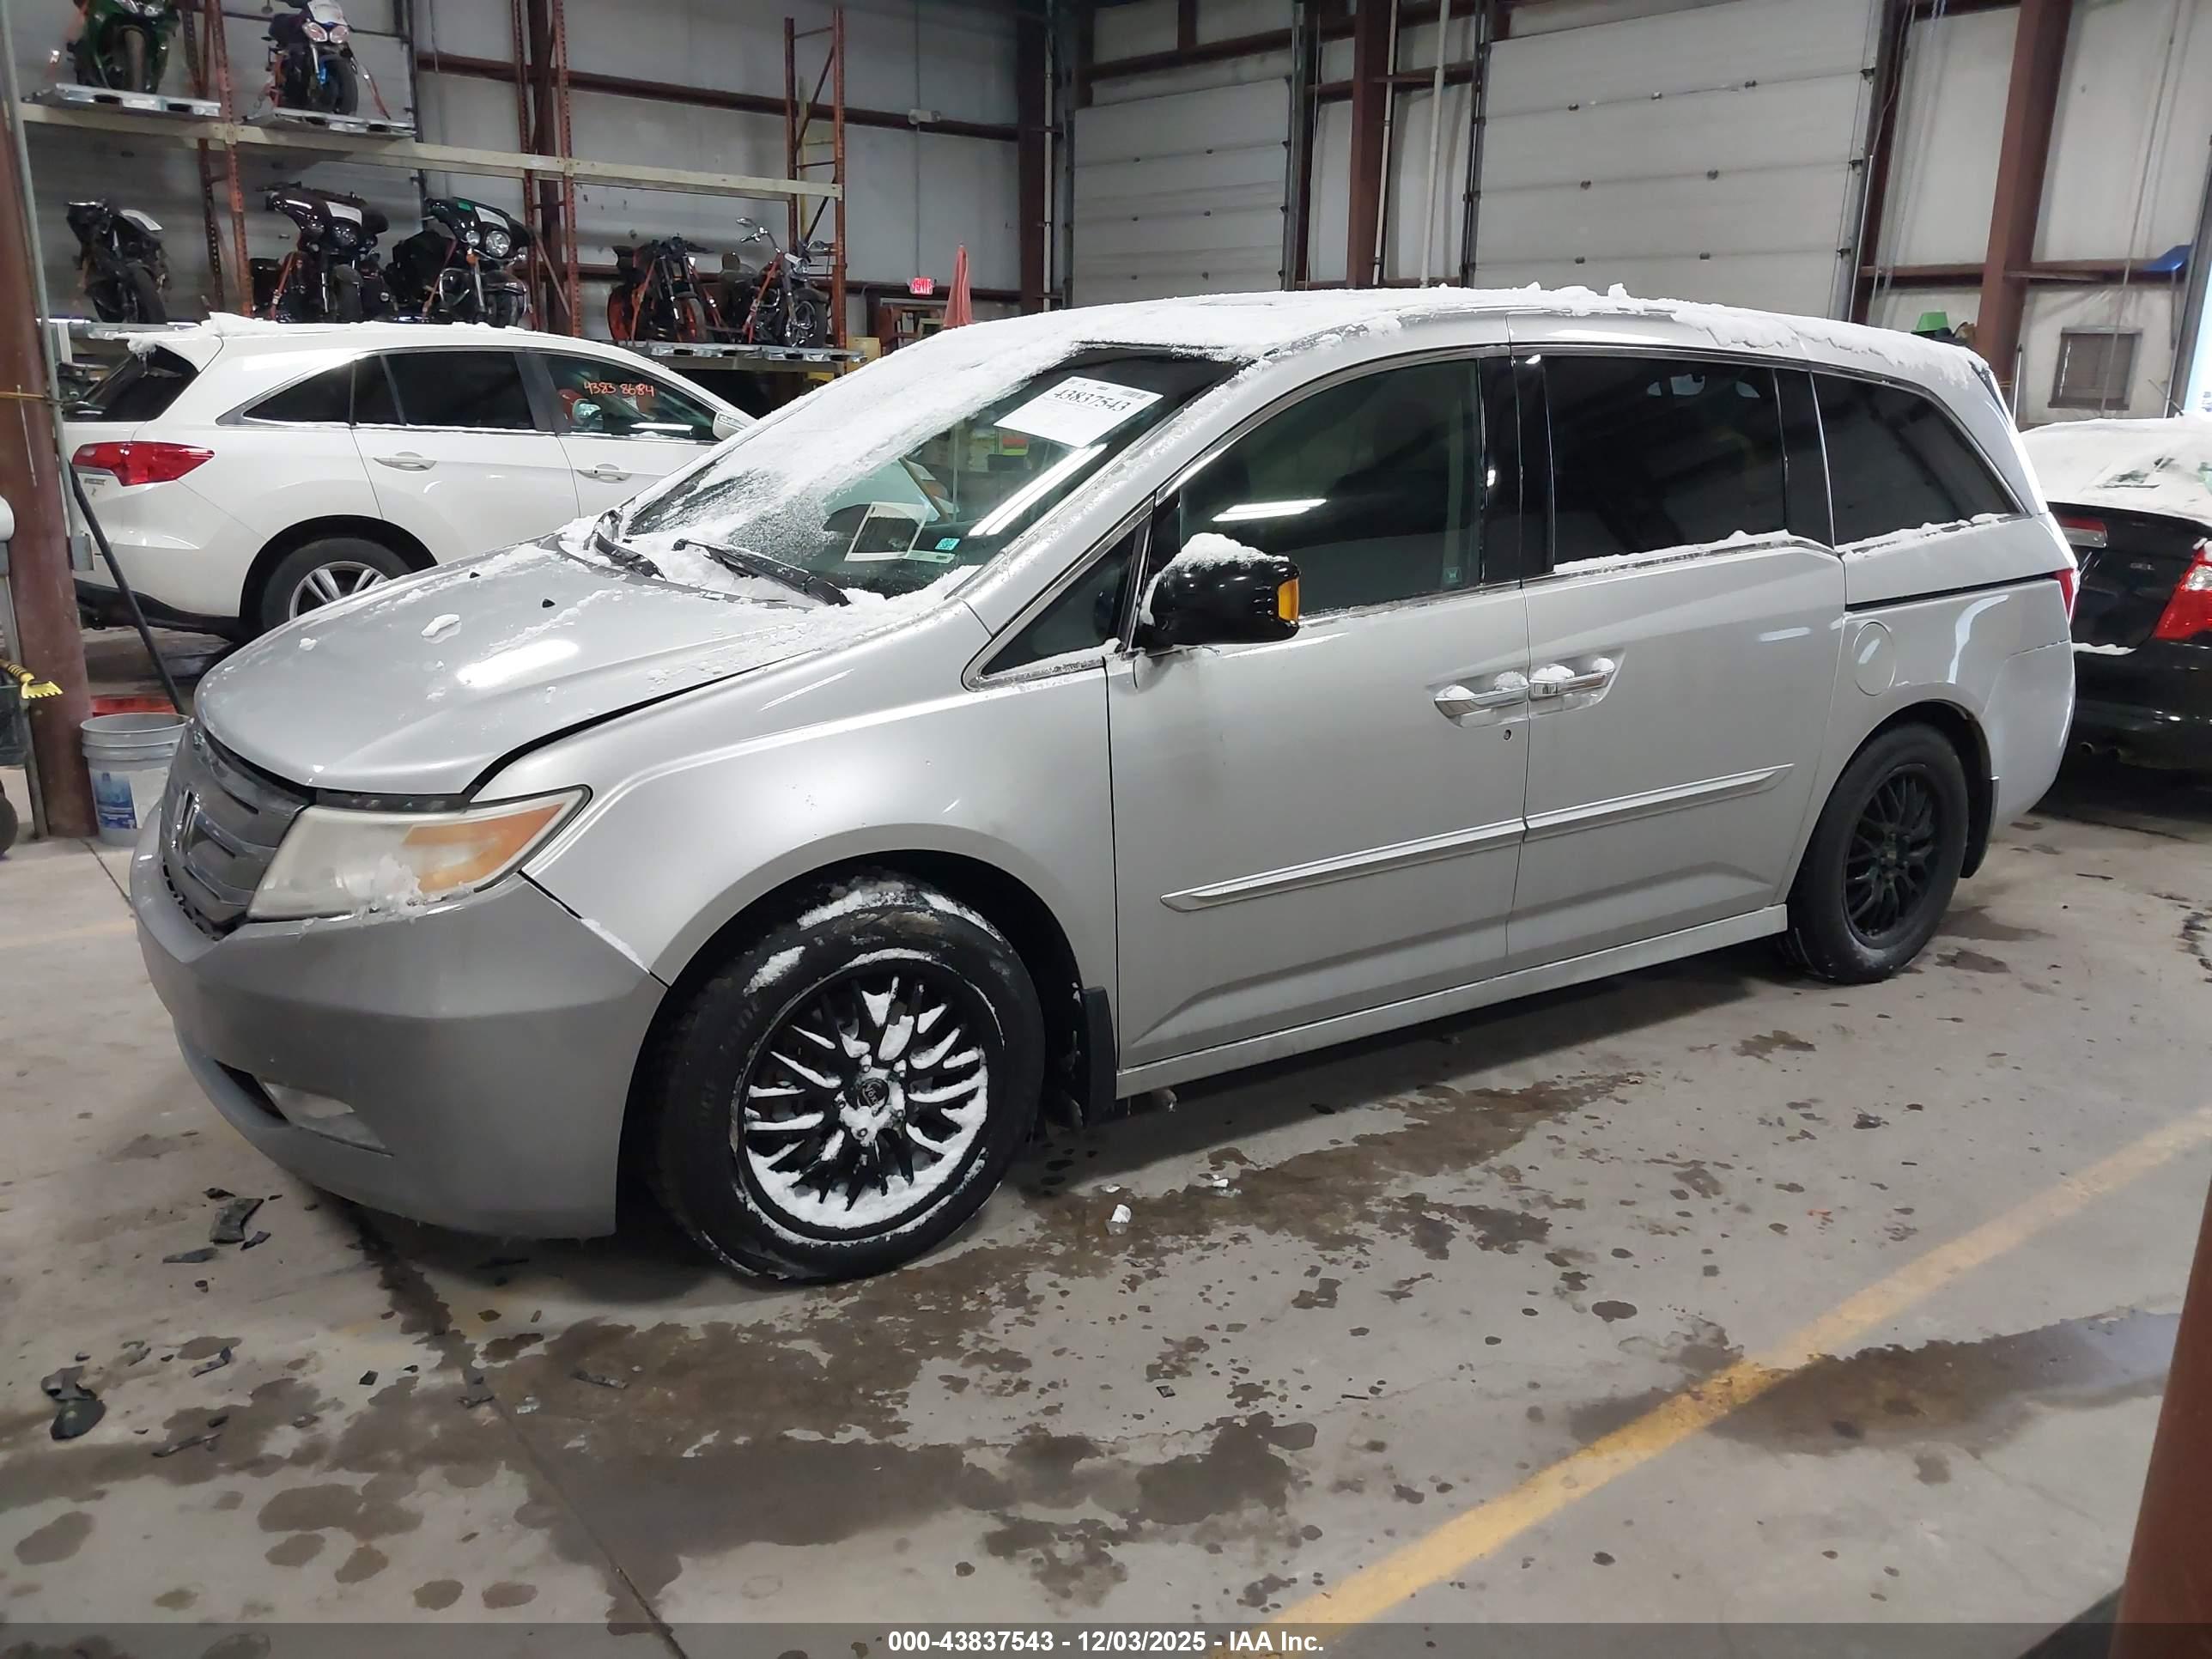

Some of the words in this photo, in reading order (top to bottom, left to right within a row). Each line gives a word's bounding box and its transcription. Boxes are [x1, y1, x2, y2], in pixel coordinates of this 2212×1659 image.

[914, 277, 931, 294] EXIT
[583, 381, 617, 395] 4383
[619, 383, 655, 398] 8684
[1054, 389, 1132, 412] 43837543
